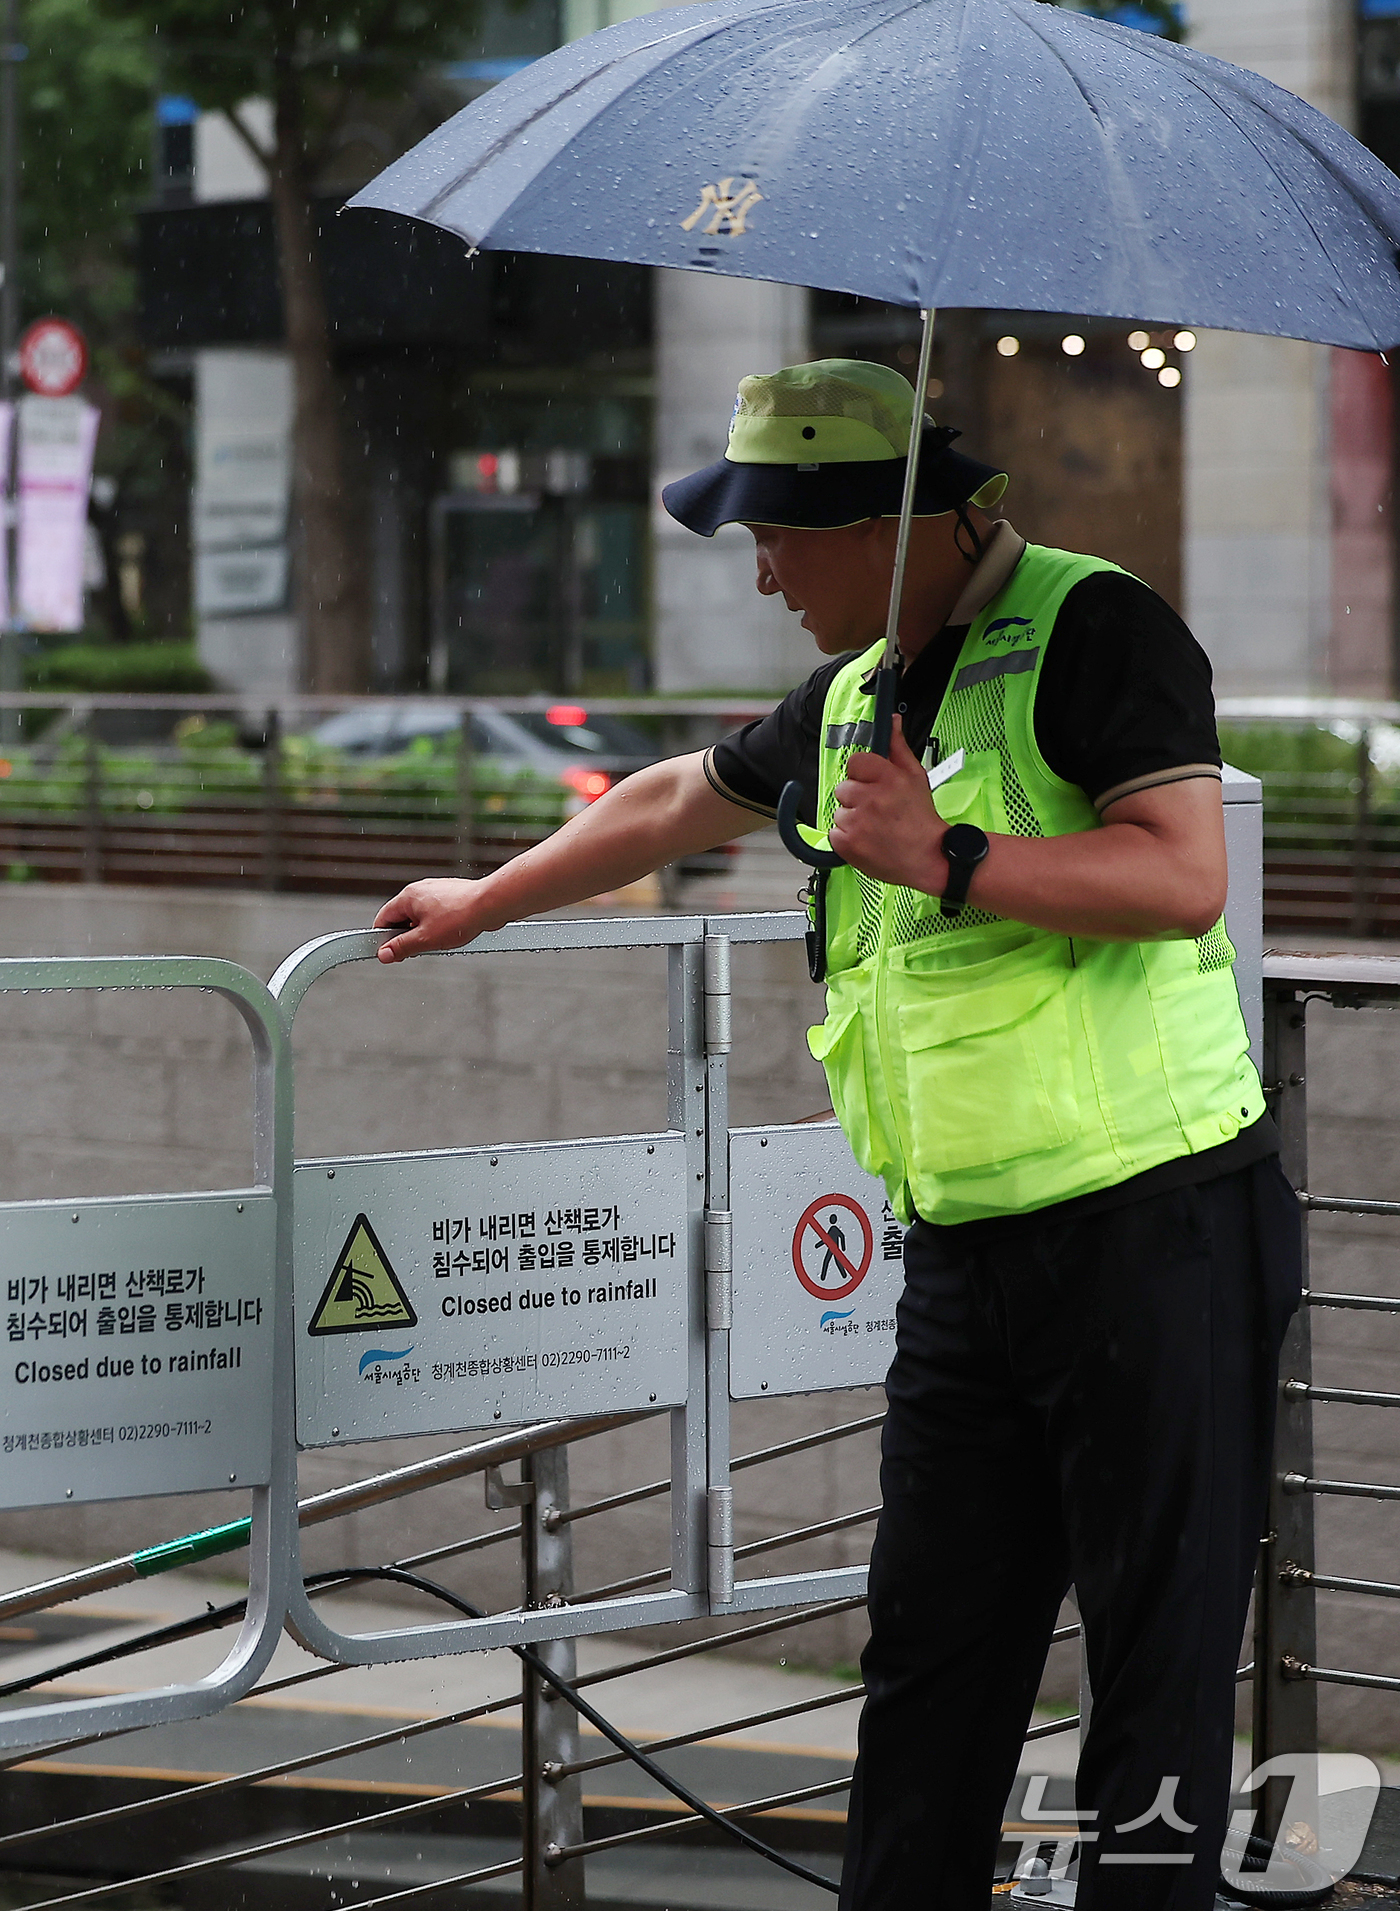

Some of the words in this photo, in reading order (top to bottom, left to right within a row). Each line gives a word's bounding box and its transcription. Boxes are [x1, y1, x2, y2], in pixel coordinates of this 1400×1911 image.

[432, 1219, 471, 1246] 비가
[479, 1212, 536, 1242] 내리면
[544, 1205, 620, 1237] 산책로가
[432, 1247, 509, 1279] 침수되어
[517, 1241, 575, 1271] 출입을
[582, 1232, 676, 1266] 통제합니다
[7, 1276, 49, 1305] 비가
[57, 1271, 117, 1302] 내리면
[125, 1266, 206, 1299] 산책로가
[441, 1291, 512, 1317] Closed
[518, 1286, 555, 1310] due
[561, 1285, 582, 1307] to
[588, 1278, 657, 1303] rainfall
[6, 1309, 88, 1342] 침수되어
[96, 1304, 157, 1336] 출입을
[164, 1297, 263, 1332] 통제합니다
[823, 1320, 860, 1336] 서울시설공단
[14, 1358, 89, 1384] Closed
[96, 1355, 134, 1378] due
[141, 1354, 162, 1375] to
[169, 1347, 241, 1373] rainfall
[363, 1362, 421, 1386] 서울시설공단
[431, 1354, 538, 1381] 청계천종합상황센터
[2, 1426, 114, 1454] 청계천종합상황센터
